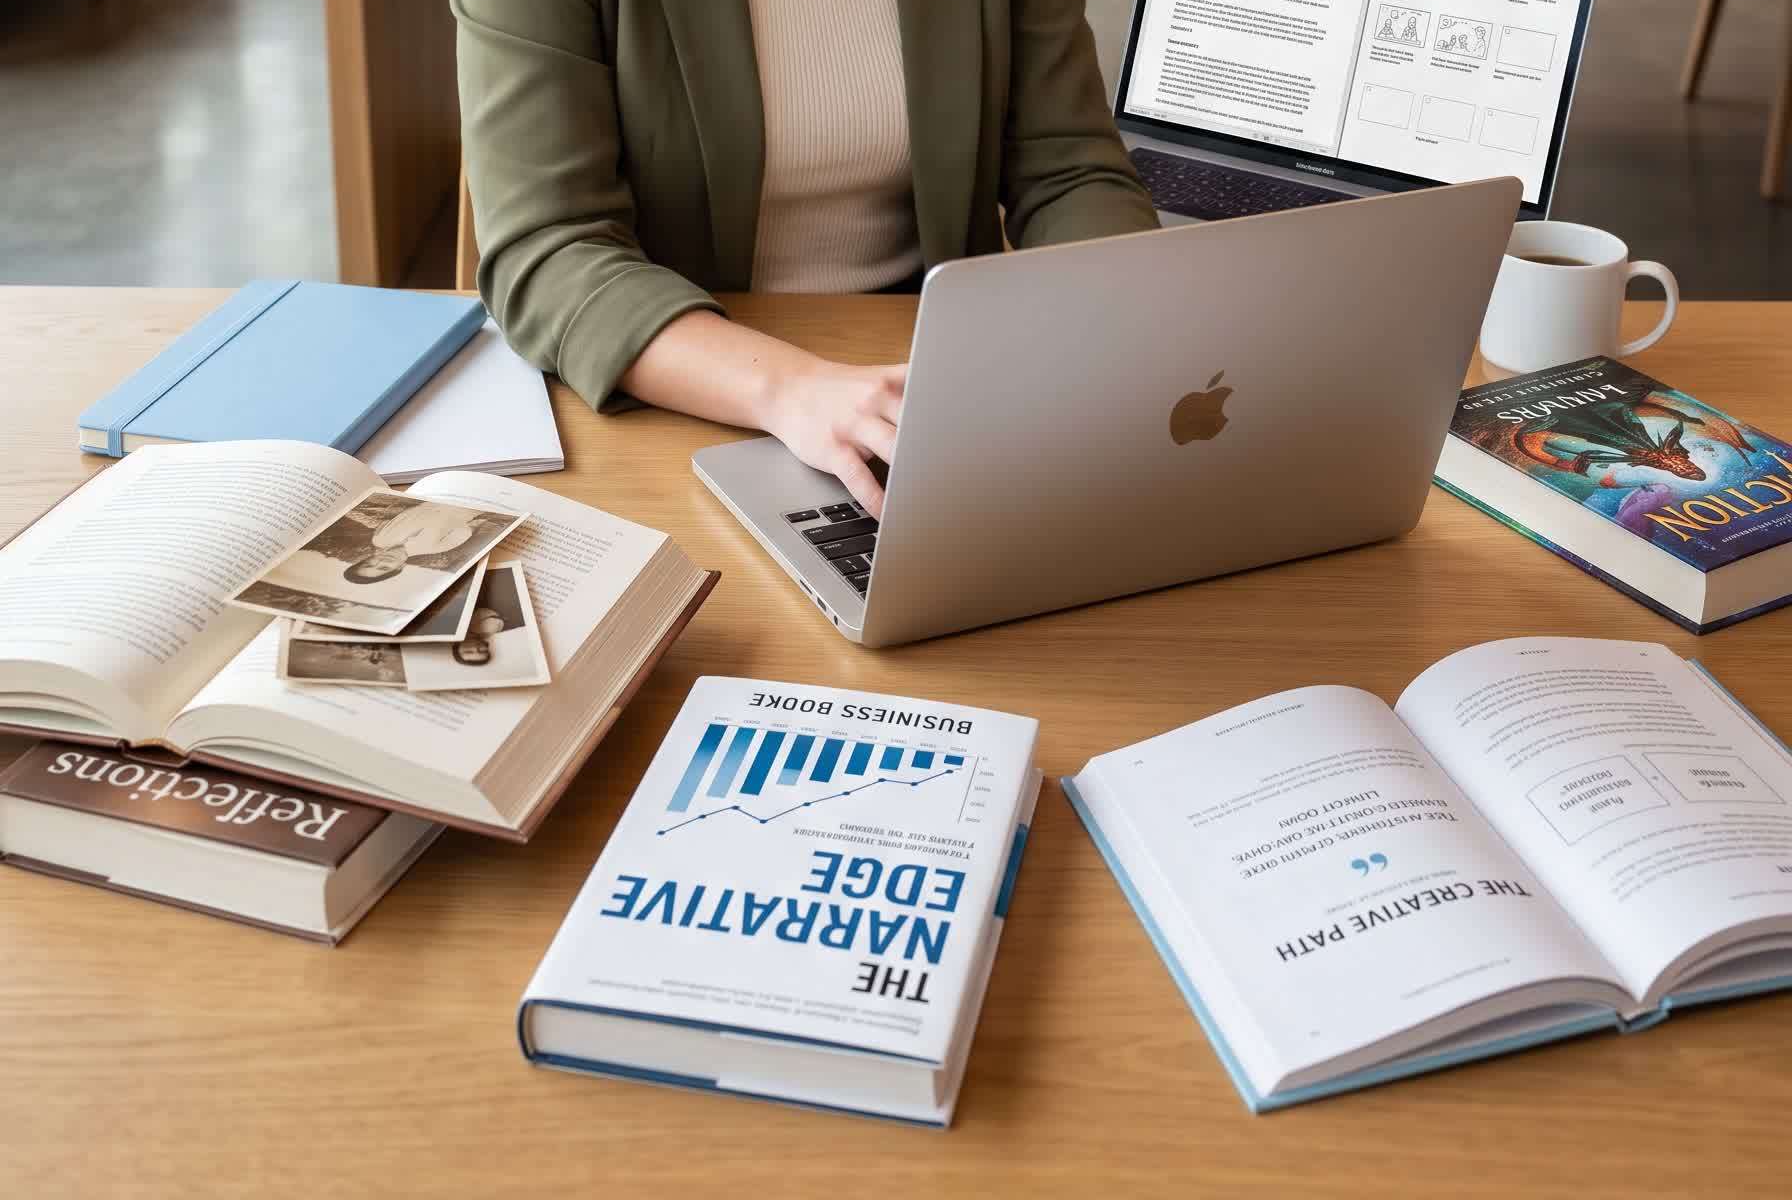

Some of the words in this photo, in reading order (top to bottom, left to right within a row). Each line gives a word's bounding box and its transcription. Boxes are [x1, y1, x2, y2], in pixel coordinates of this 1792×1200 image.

[47, 752, 348, 840] Reflections
[800, 850, 967, 913] EDGE
[1349, 881, 1474, 933] CREATIVE
[1477, 879, 1532, 897] THE
[600, 874, 951, 965] NARRATIVE
[1275, 923, 1346, 963] PATH
[851, 962, 929, 1003] THE
